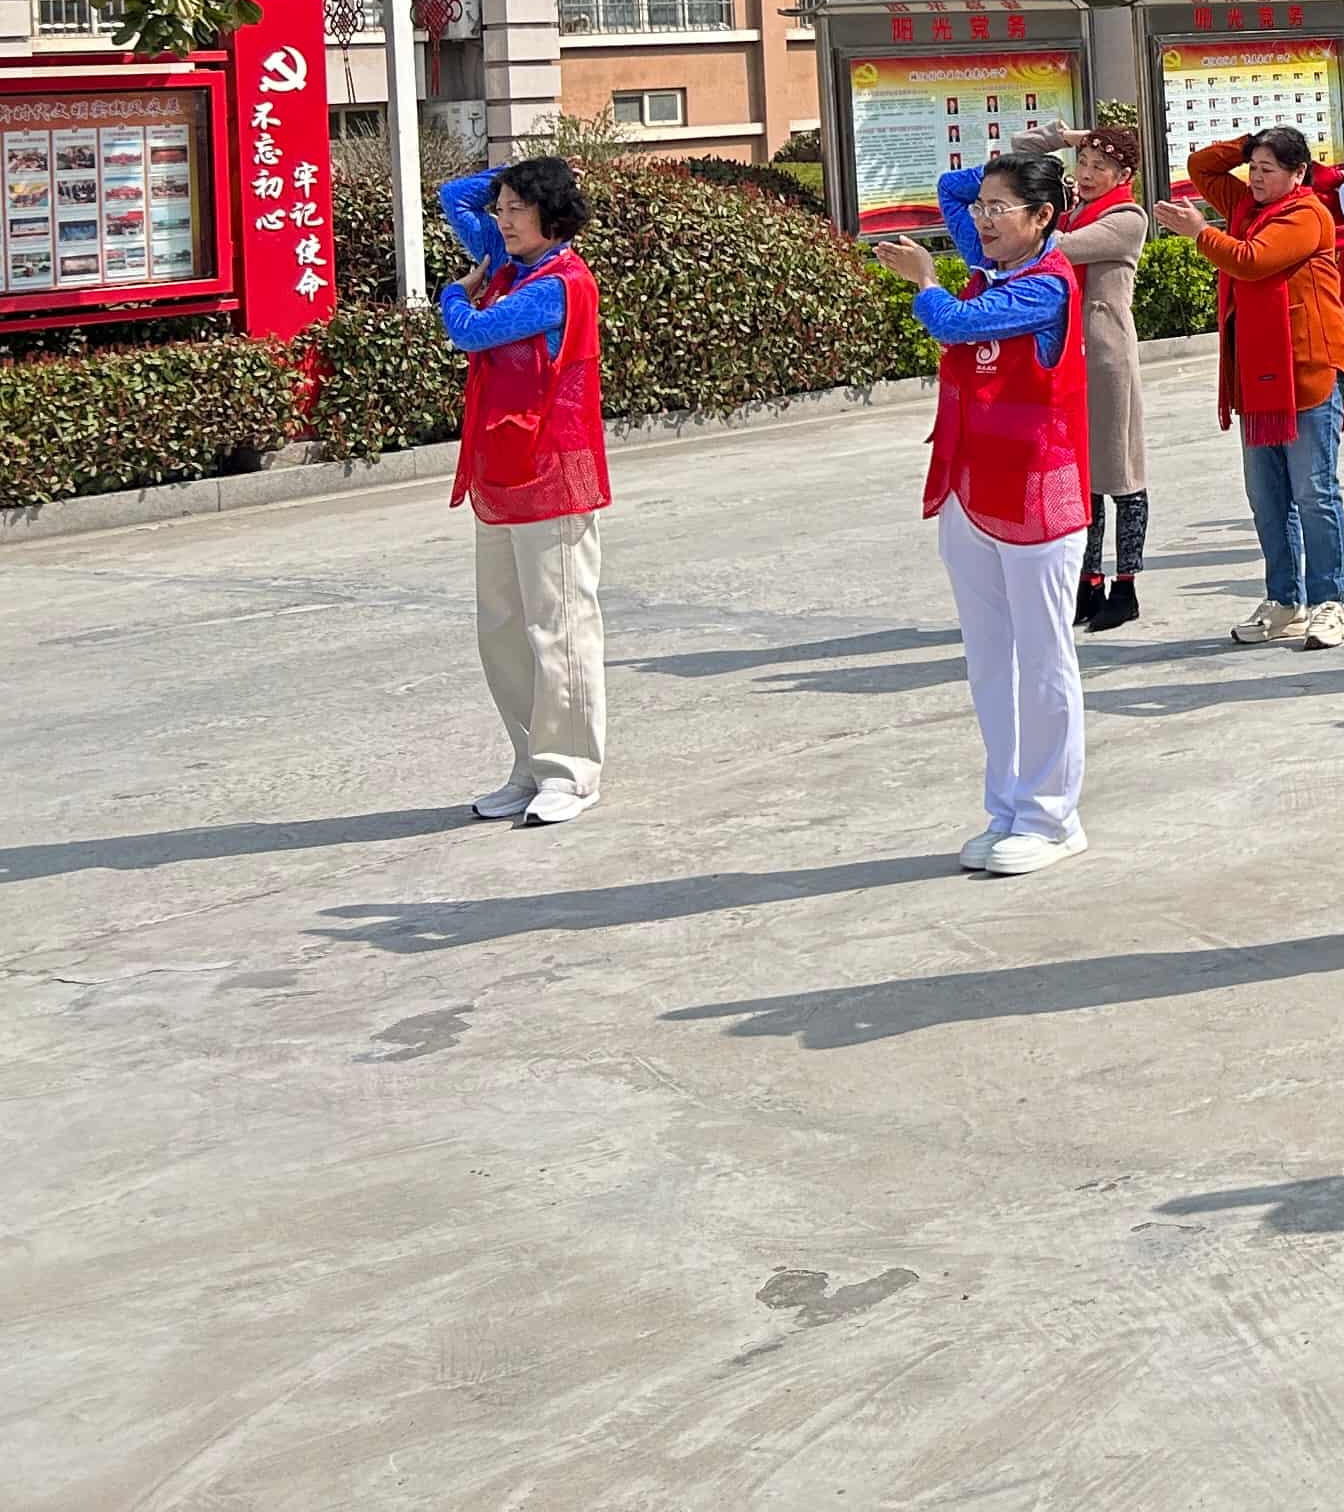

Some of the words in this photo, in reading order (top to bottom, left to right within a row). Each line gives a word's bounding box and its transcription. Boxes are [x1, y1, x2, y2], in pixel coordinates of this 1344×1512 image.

[892, 14, 1027, 41] 阳光党务
[1193, 5, 1305, 30] 阳光党务
[251, 102, 286, 231] 不忘初心
[289, 160, 329, 303] 牢记使命
